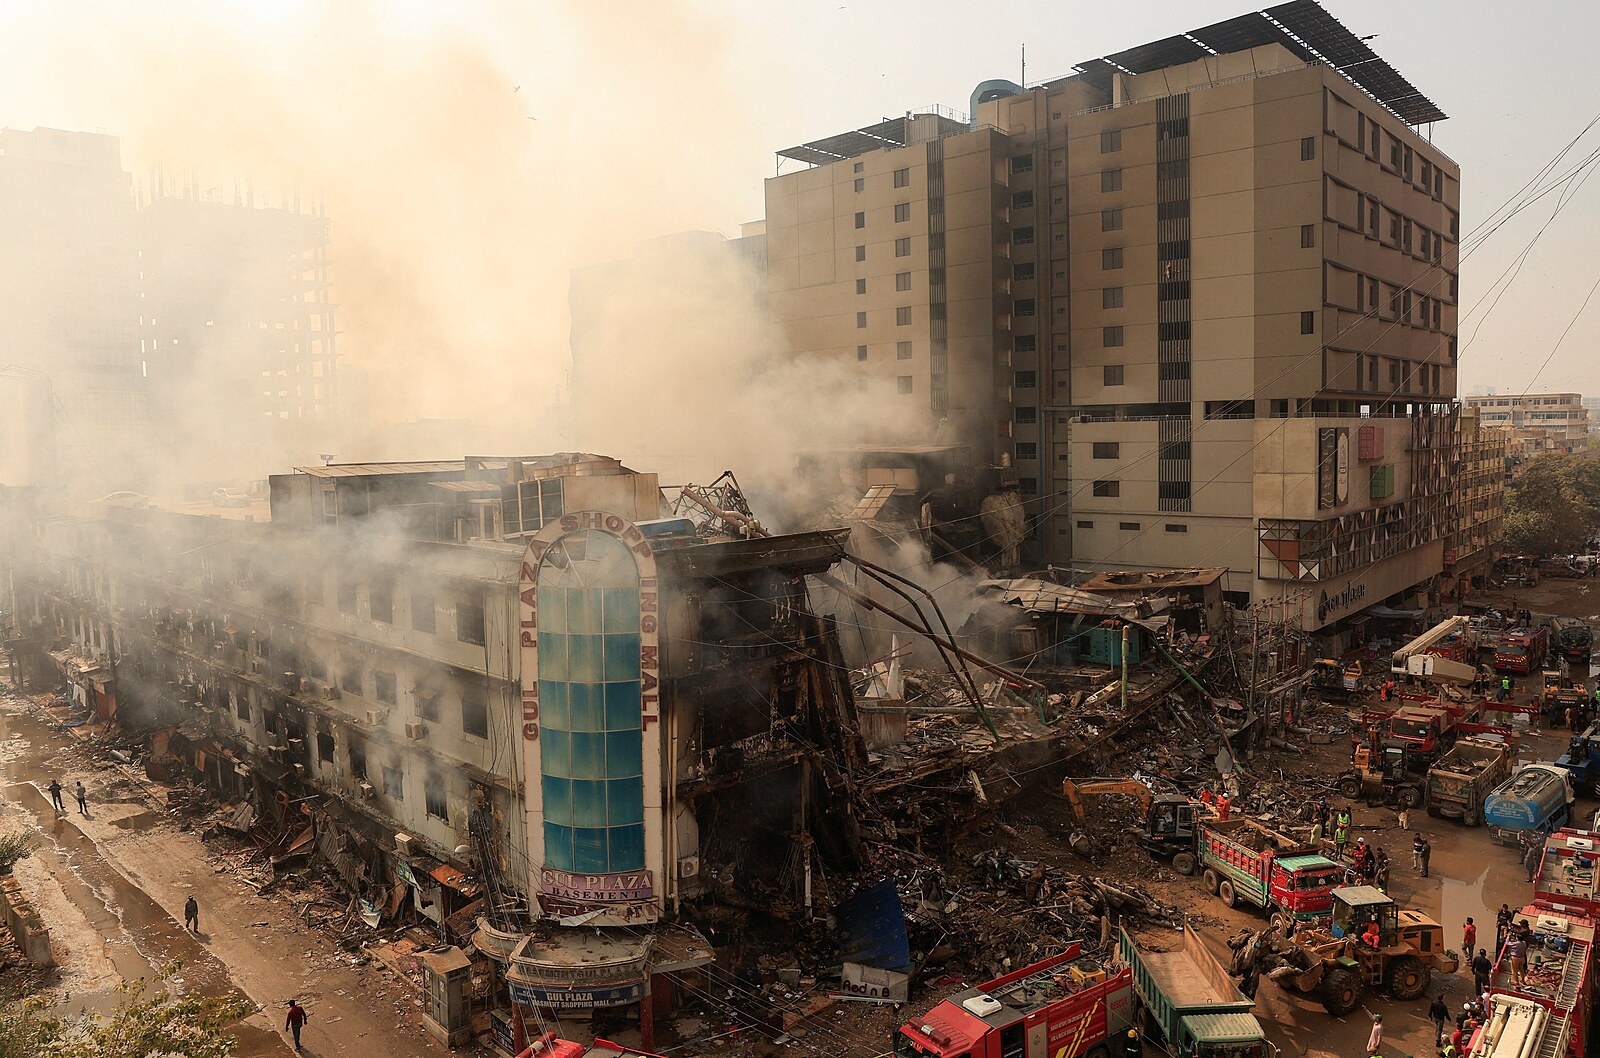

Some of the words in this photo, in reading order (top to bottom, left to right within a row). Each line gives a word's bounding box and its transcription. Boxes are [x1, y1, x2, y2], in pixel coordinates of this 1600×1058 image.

[520, 539, 549, 648] PLAZA
[641, 645, 658, 732] MALL
[522, 680, 539, 741] GUL
[542, 870, 578, 889] GUL
[585, 875, 652, 891] PLAZA
[552, 887, 641, 900] BASEMENT
[546, 992, 565, 1001] GUL
[565, 992, 594, 1001] PLAZA
